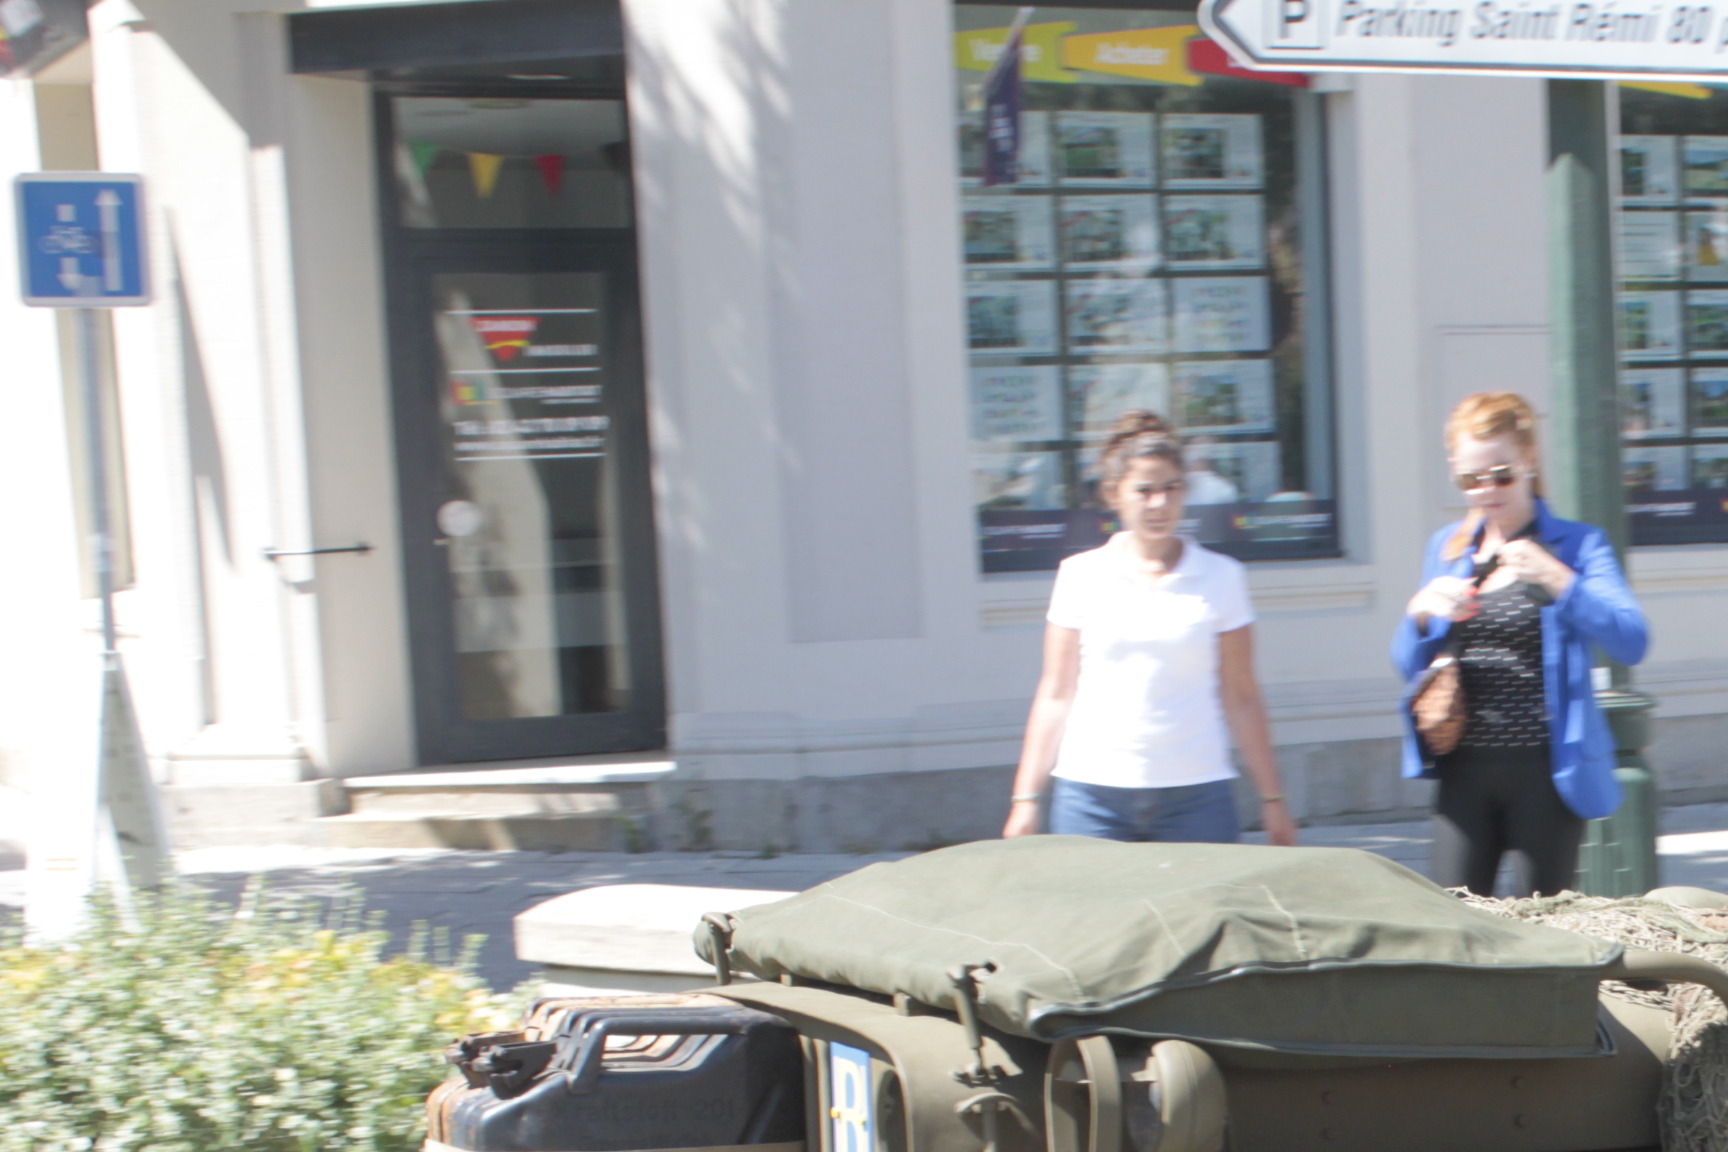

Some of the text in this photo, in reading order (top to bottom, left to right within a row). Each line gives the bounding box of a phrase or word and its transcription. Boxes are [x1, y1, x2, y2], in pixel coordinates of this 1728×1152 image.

[1279, 0, 1310, 39] P
[1335, 0, 1461, 48] Parking
[1470, 1, 1560, 40] Saint
[1564, 0, 1662, 43] Rémi
[1667, 5, 1714, 44] 80
